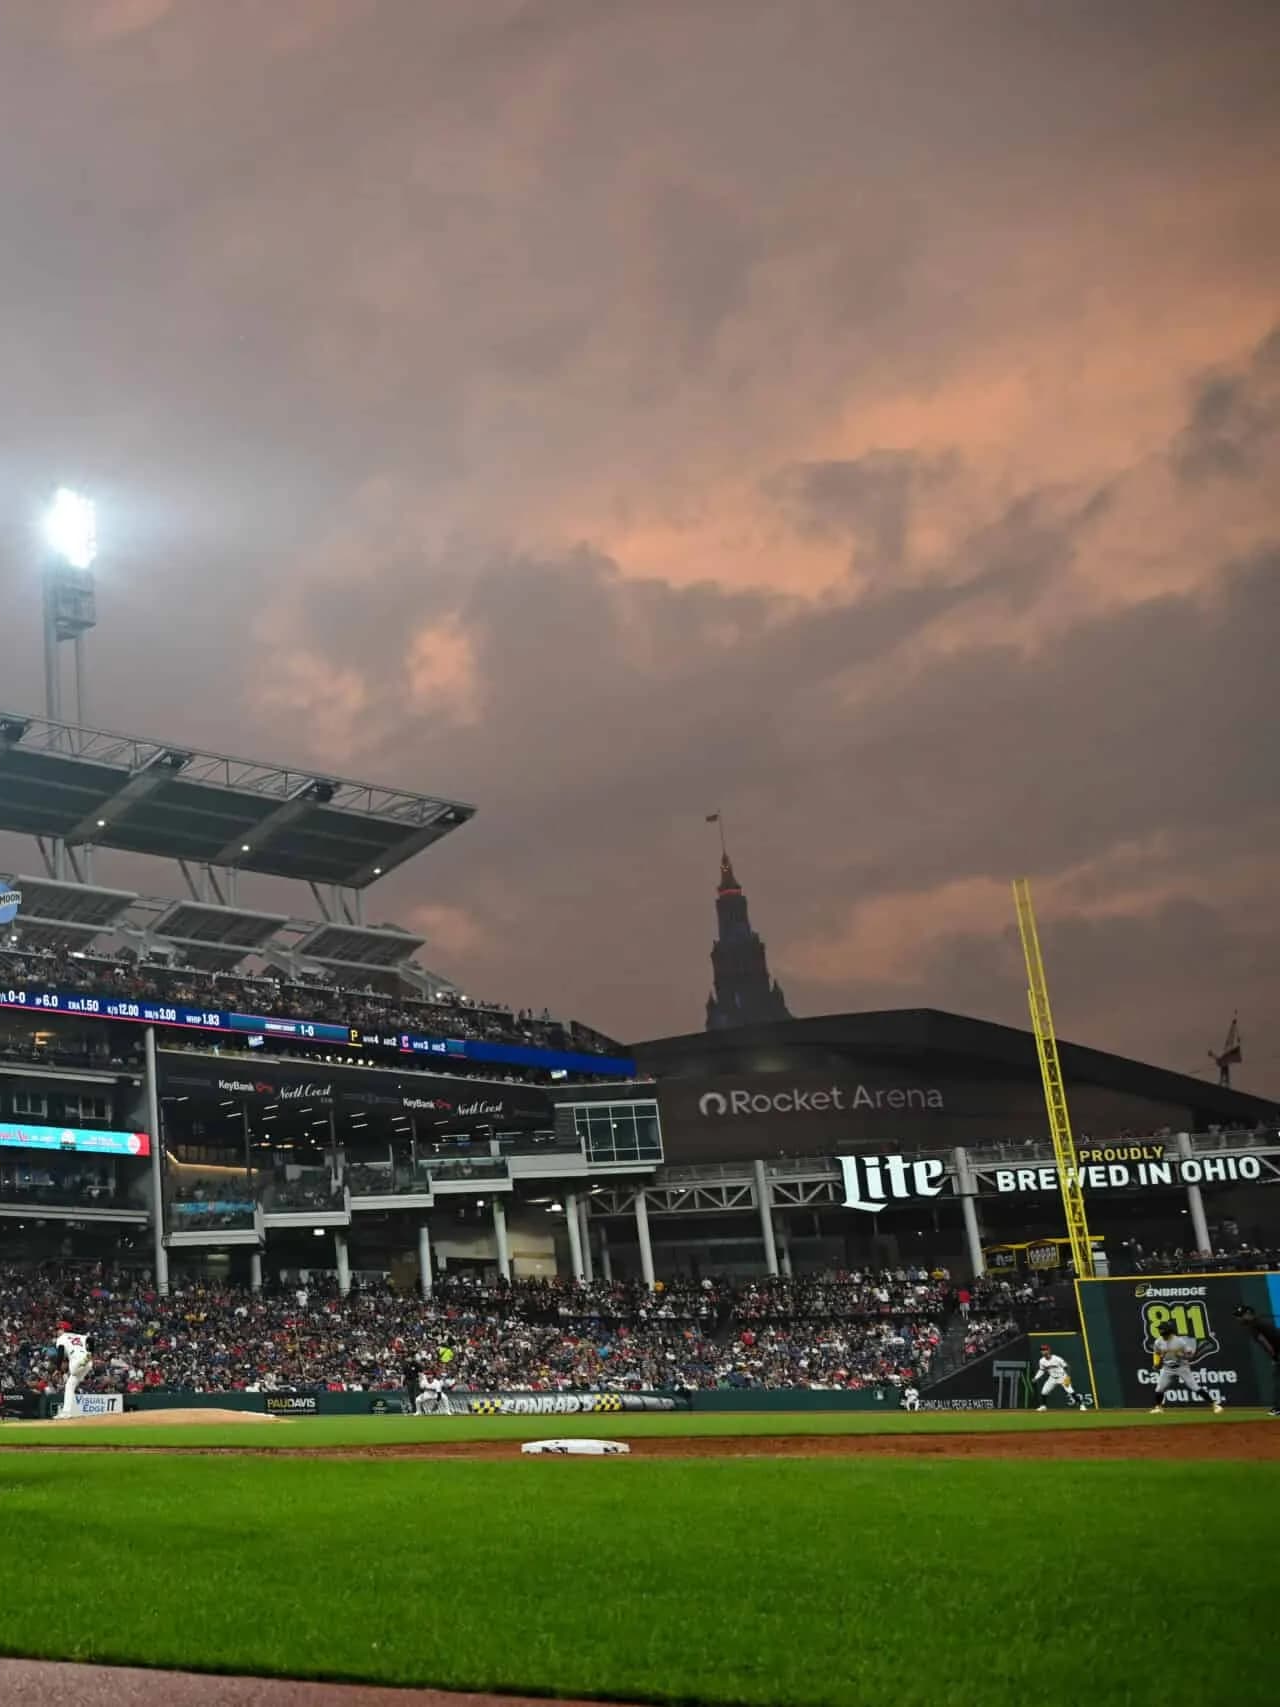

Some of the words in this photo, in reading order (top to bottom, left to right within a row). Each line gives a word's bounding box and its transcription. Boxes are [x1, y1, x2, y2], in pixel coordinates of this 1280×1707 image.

[0, 893, 20, 905] MOON
[8, 991, 26, 1004] 0-0
[42, 994, 58, 1007] 6.0
[80, 999, 100, 1012] 1.50
[118, 1004, 139, 1017] 12.00
[159, 1008, 177, 1021] 3.00
[186, 1015, 202, 1024] WHIP
[202, 1013, 220, 1026] 1.83
[300, 1024, 315, 1037] 1-0
[218, 1079, 256, 1092] KeyBank
[279, 1083, 305, 1101] North
[402, 1097, 435, 1110] KeyBank
[730, 1085, 845, 1115] Rocket
[851, 1084, 945, 1110] Arena
[457, 1101, 479, 1117] North
[1079, 1145, 1164, 1163] PROUDLY
[1138, 1161, 1172, 1186] IN
[1180, 1156, 1261, 1183] OHIO
[834, 1154, 945, 1213] Lite
[1146, 1286, 1208, 1298] ENBRIDGE
[1147, 1304, 1207, 1339] 811
[1137, 1368, 1165, 1385] Ca
[1179, 1367, 1238, 1384] efore
[83, 1404, 105, 1413] EDGE
[107, 1397, 117, 1412] IT
[951, 1399, 972, 1409] PEOPLE
[972, 1399, 994, 1409] MATTER
